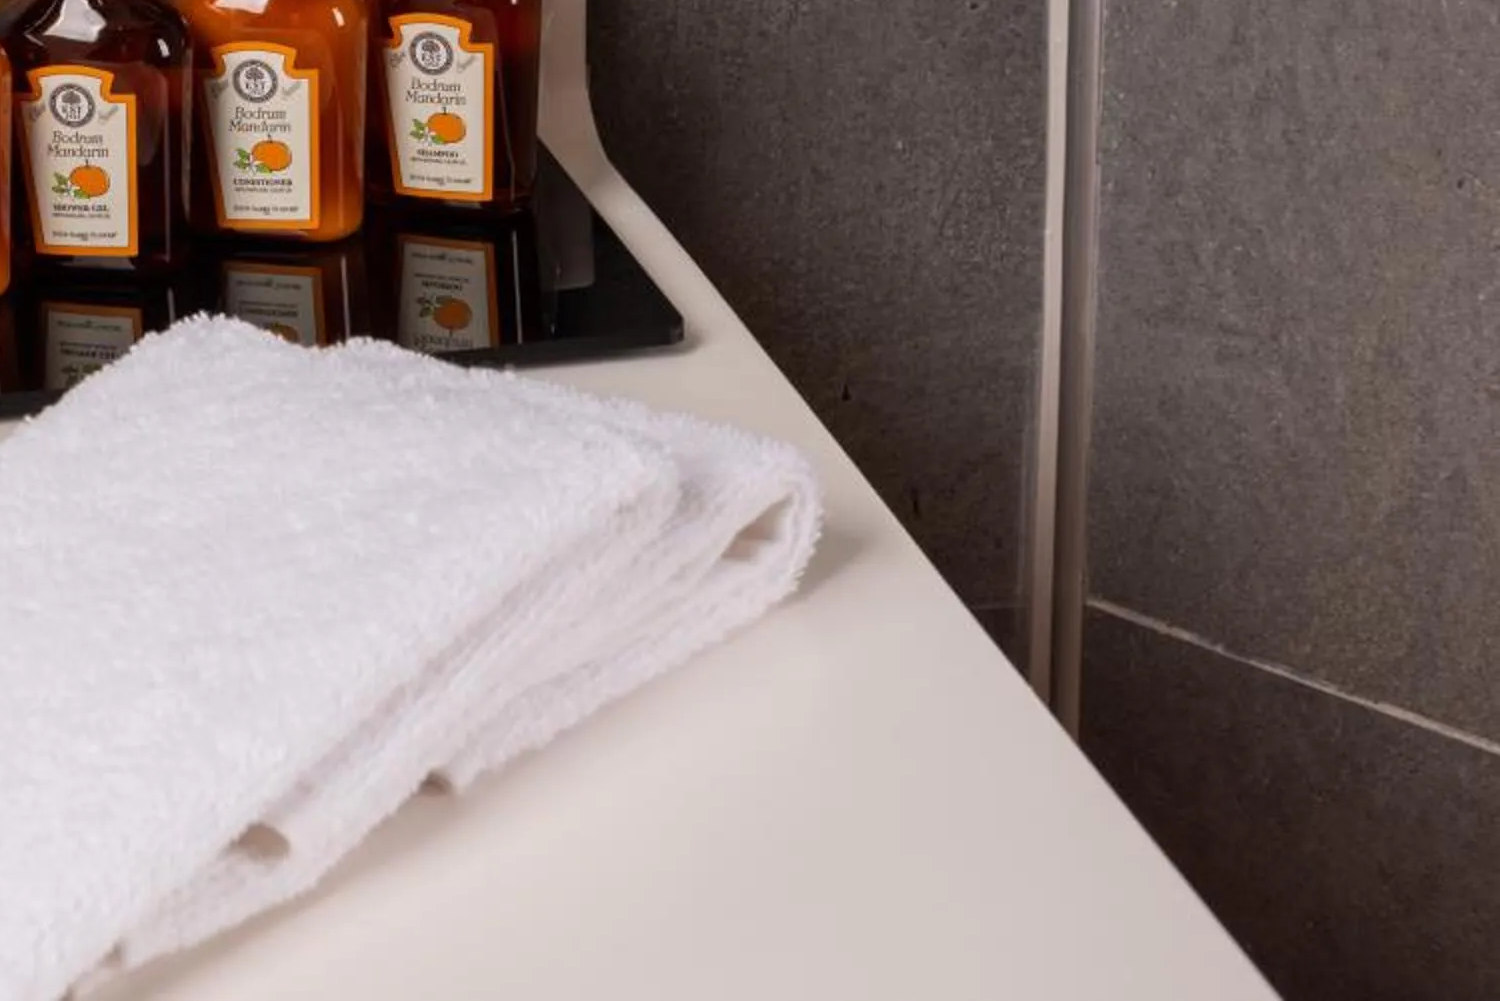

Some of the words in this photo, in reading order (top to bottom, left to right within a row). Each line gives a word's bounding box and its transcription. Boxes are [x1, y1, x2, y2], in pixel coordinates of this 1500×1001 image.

[411, 78, 461, 92] Bodrum
[405, 90, 467, 106] Mandarin
[235, 106, 287, 120] Bodrum
[228, 118, 292, 134] Mandarin
[52, 130, 104, 144] Bodrum
[47, 142, 109, 158] Mandarin
